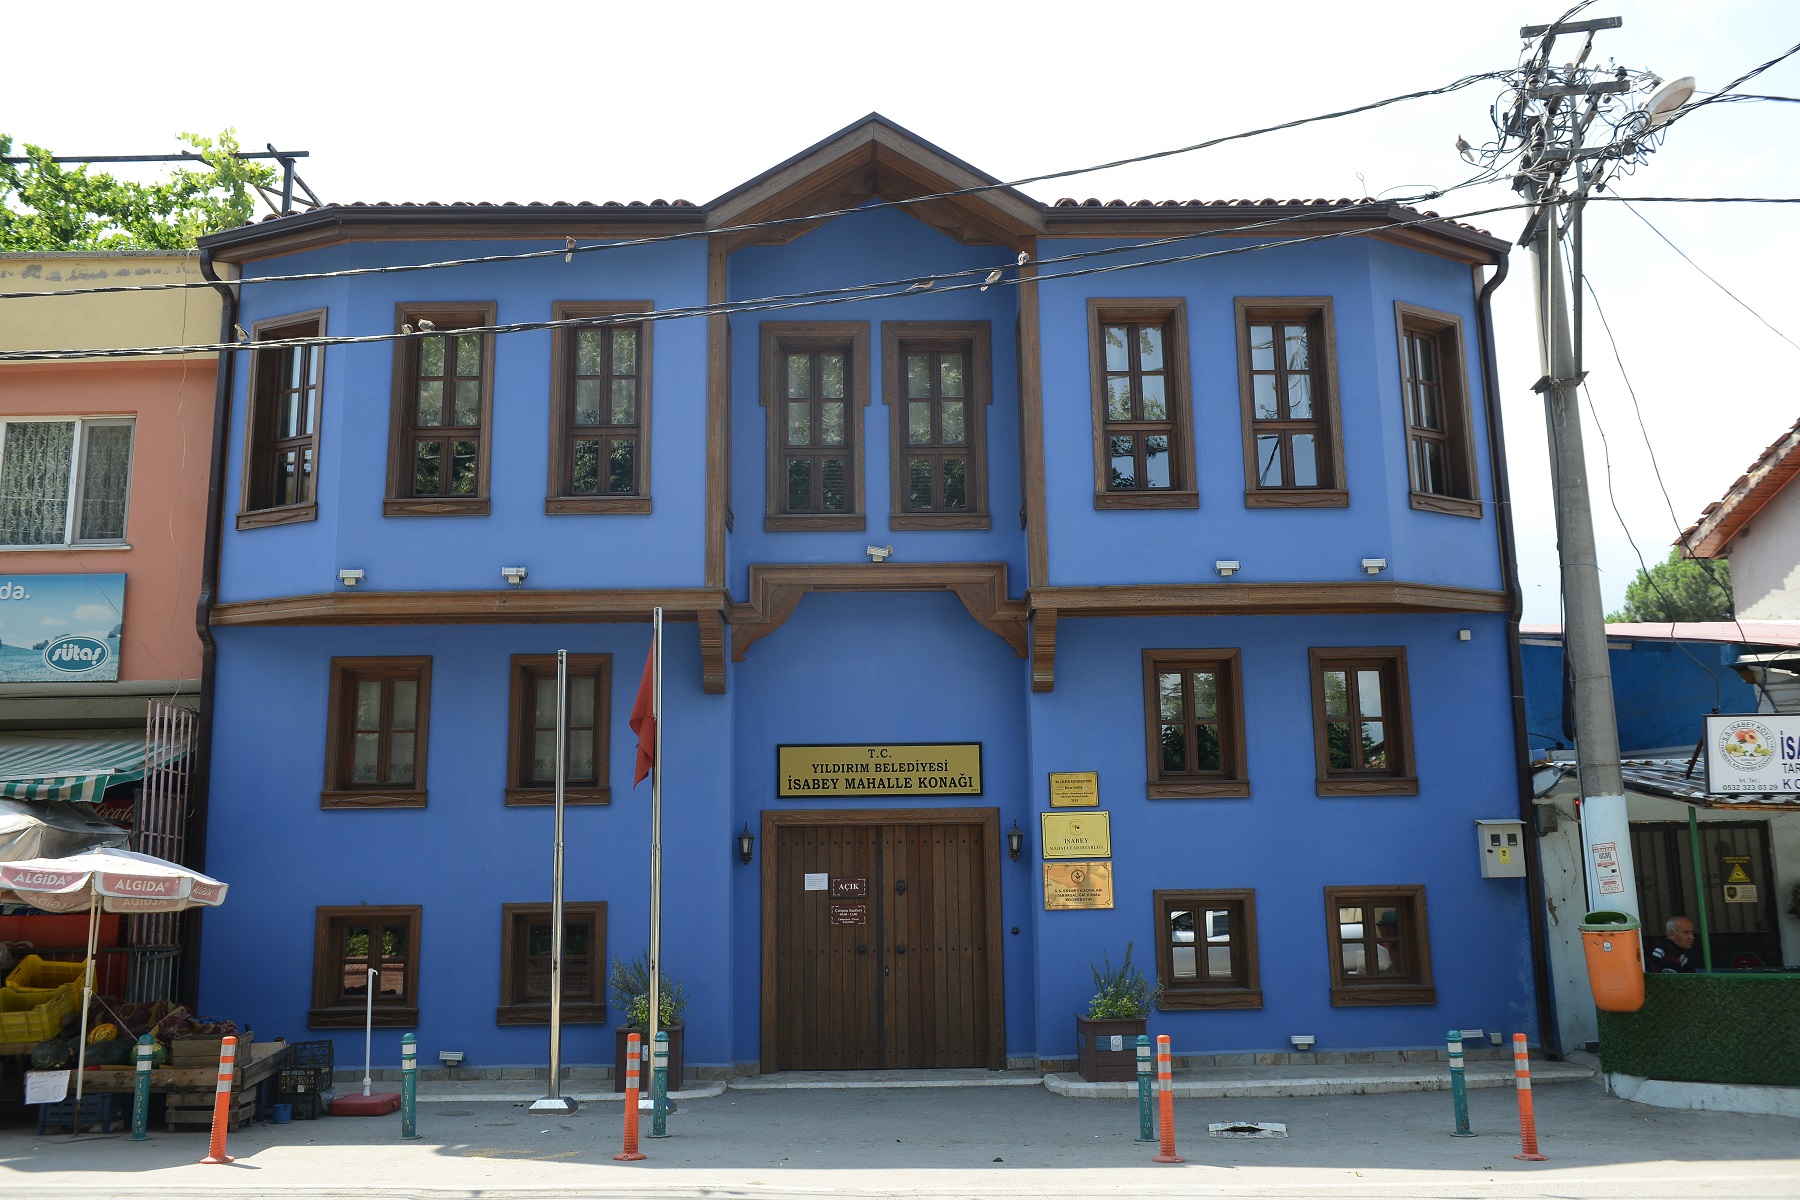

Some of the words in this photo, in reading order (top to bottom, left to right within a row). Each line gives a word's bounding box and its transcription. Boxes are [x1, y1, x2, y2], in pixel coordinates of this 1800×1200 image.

[867, 748, 892, 759] T.C.
[812, 763, 870, 774] YILDIRIM
[874, 759, 949, 773] BELEDİYESİ
[787, 775, 840, 791] İSABEY
[844, 777, 913, 790] MAHALLE
[917, 772, 974, 789] KONAĞI
